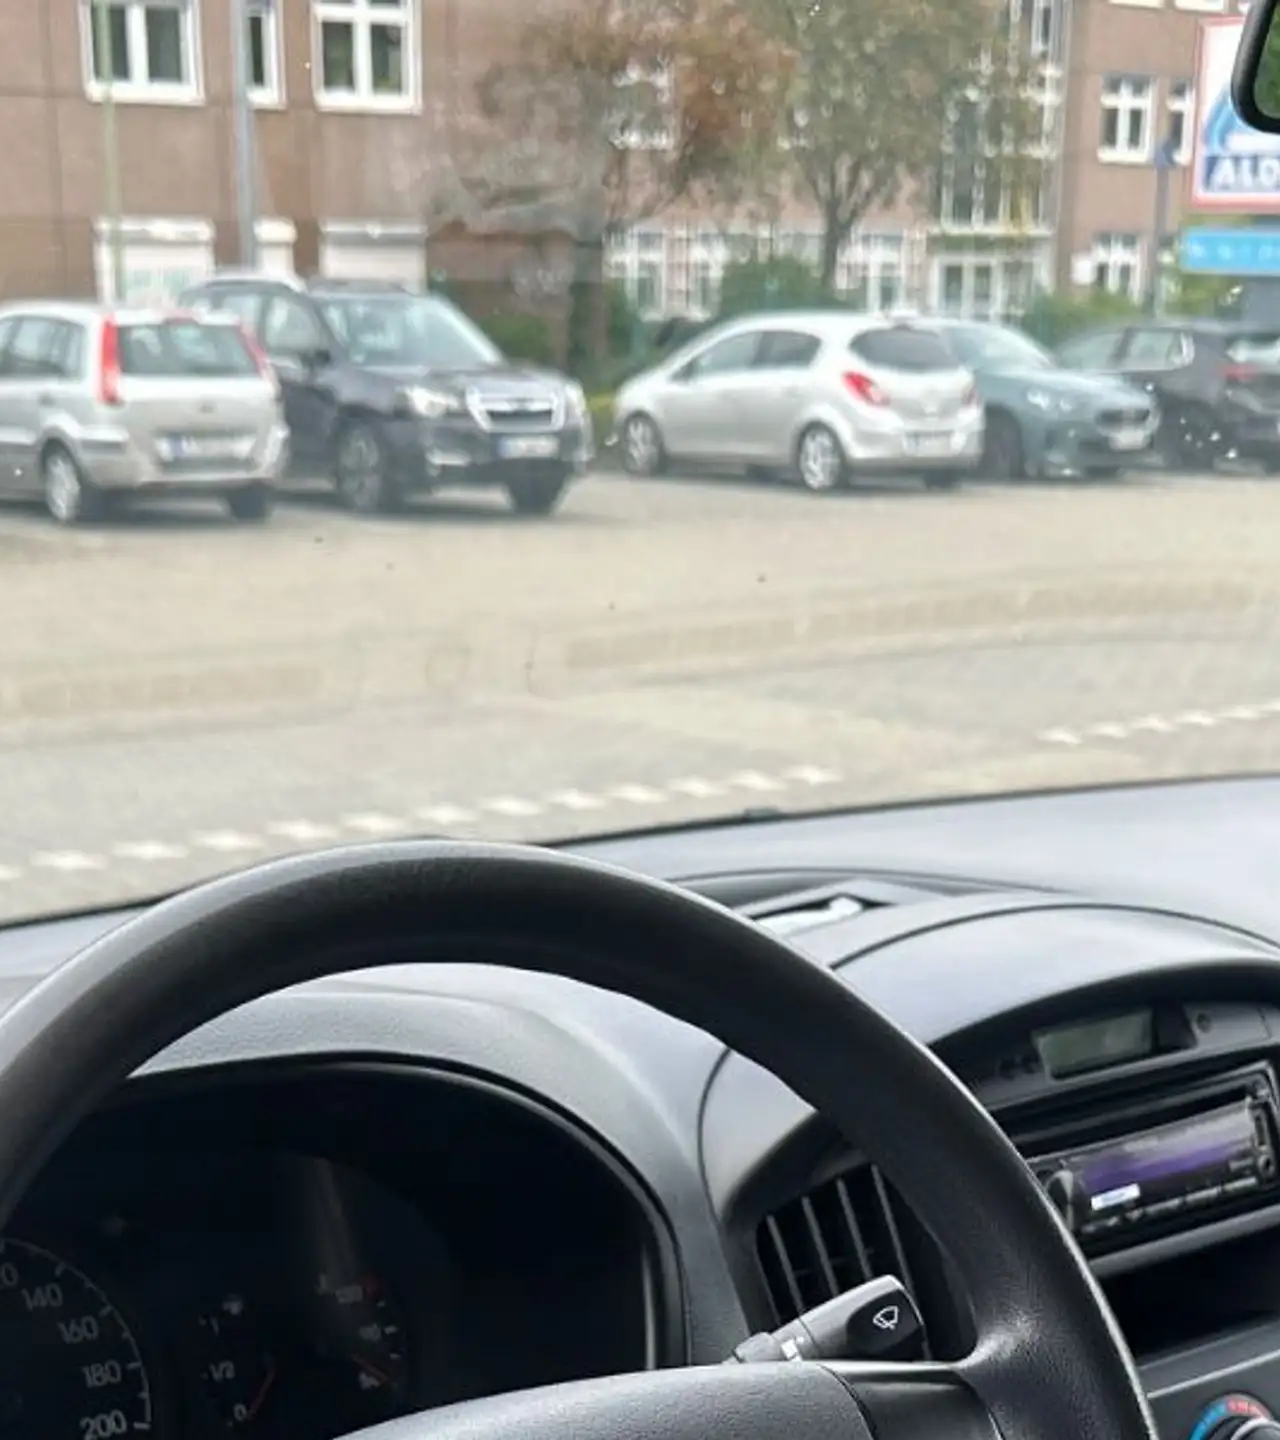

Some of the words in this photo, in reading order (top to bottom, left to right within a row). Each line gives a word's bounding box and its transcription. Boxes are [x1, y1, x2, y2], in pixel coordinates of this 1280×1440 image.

[20, 1283, 63, 1311] 140
[57, 1316, 99, 1344] 160
[81, 1359, 121, 1388] 180
